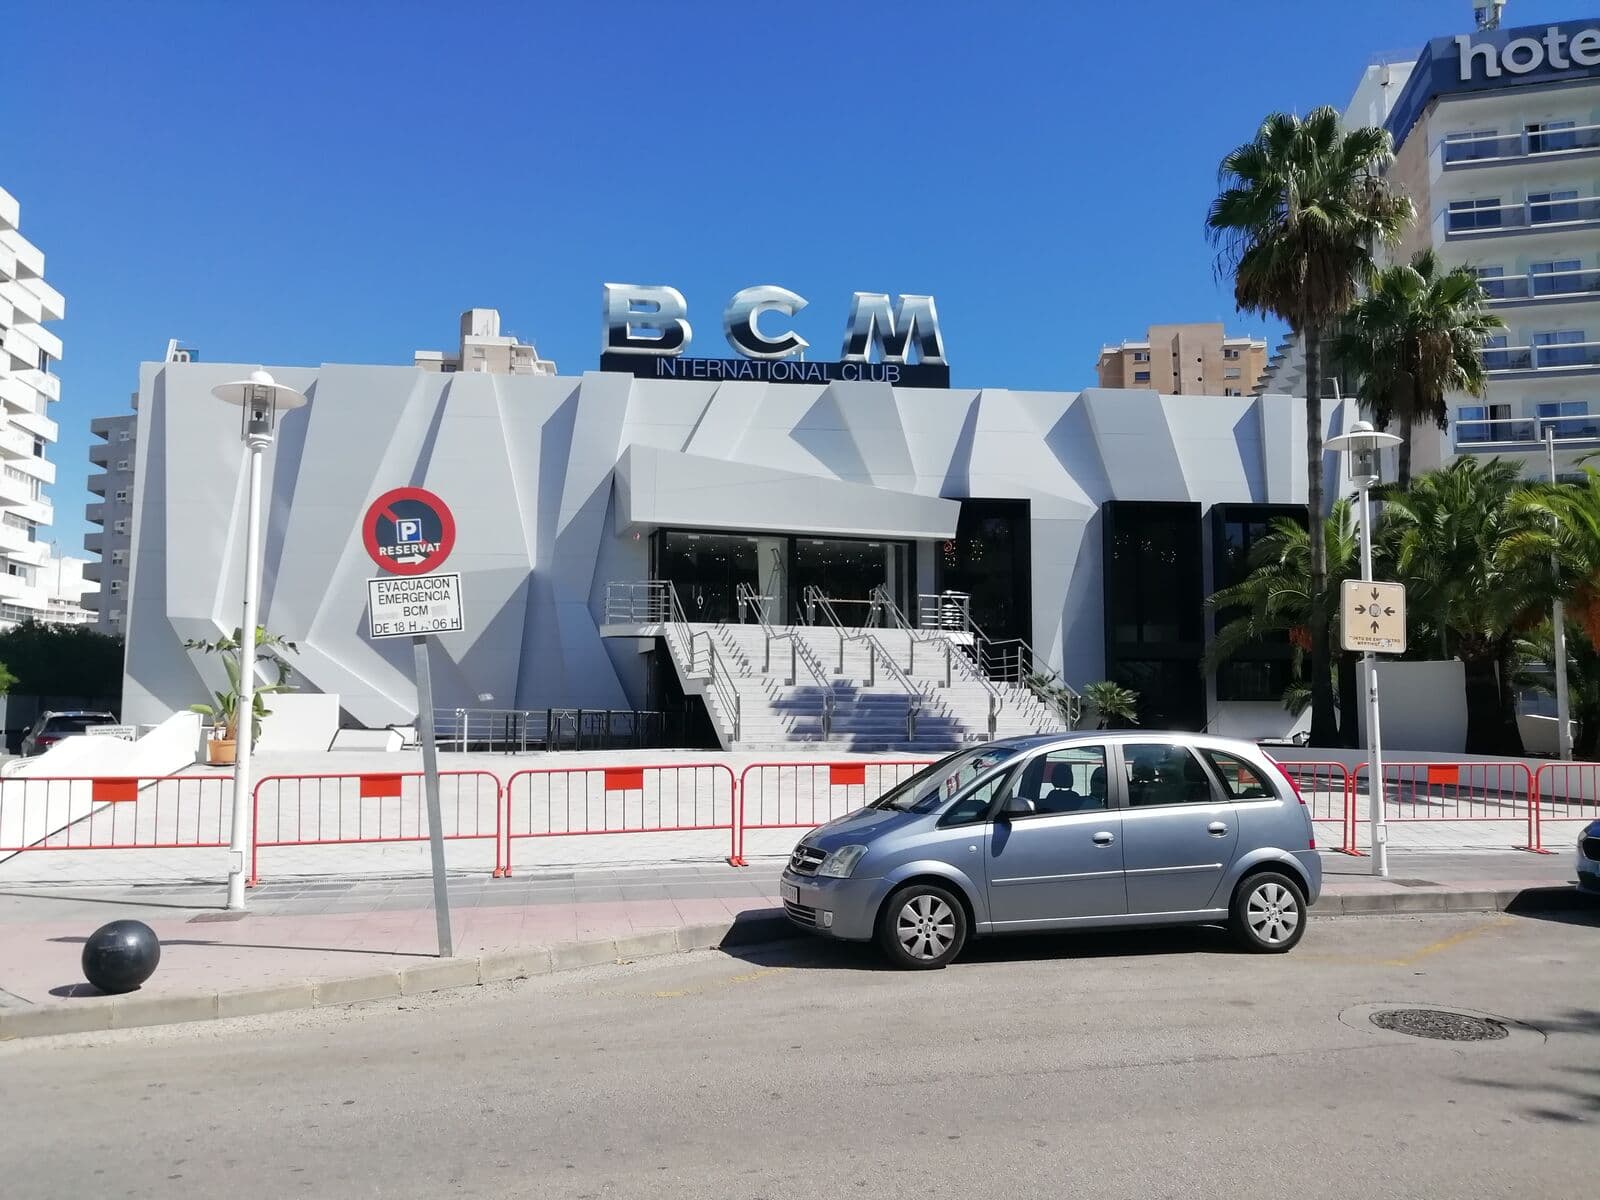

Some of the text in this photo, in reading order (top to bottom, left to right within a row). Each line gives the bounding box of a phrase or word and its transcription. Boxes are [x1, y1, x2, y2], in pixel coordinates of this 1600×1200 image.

[601, 283, 948, 366] BCM
[656, 358, 901, 383] INTERNATIONAL CLUB
[400, 522, 417, 541] P
[379, 543, 441, 557] RESERVAT
[378, 578, 450, 593] EVACUACION
[378, 590, 451, 605] EMERGENCIA
[403, 605, 429, 617] BCM
[374, 623, 390, 634] DE
[394, 621, 405, 632] 18
[408, 620, 417, 631] H
[432, 618, 447, 629] 06
[451, 618, 459, 628] H
